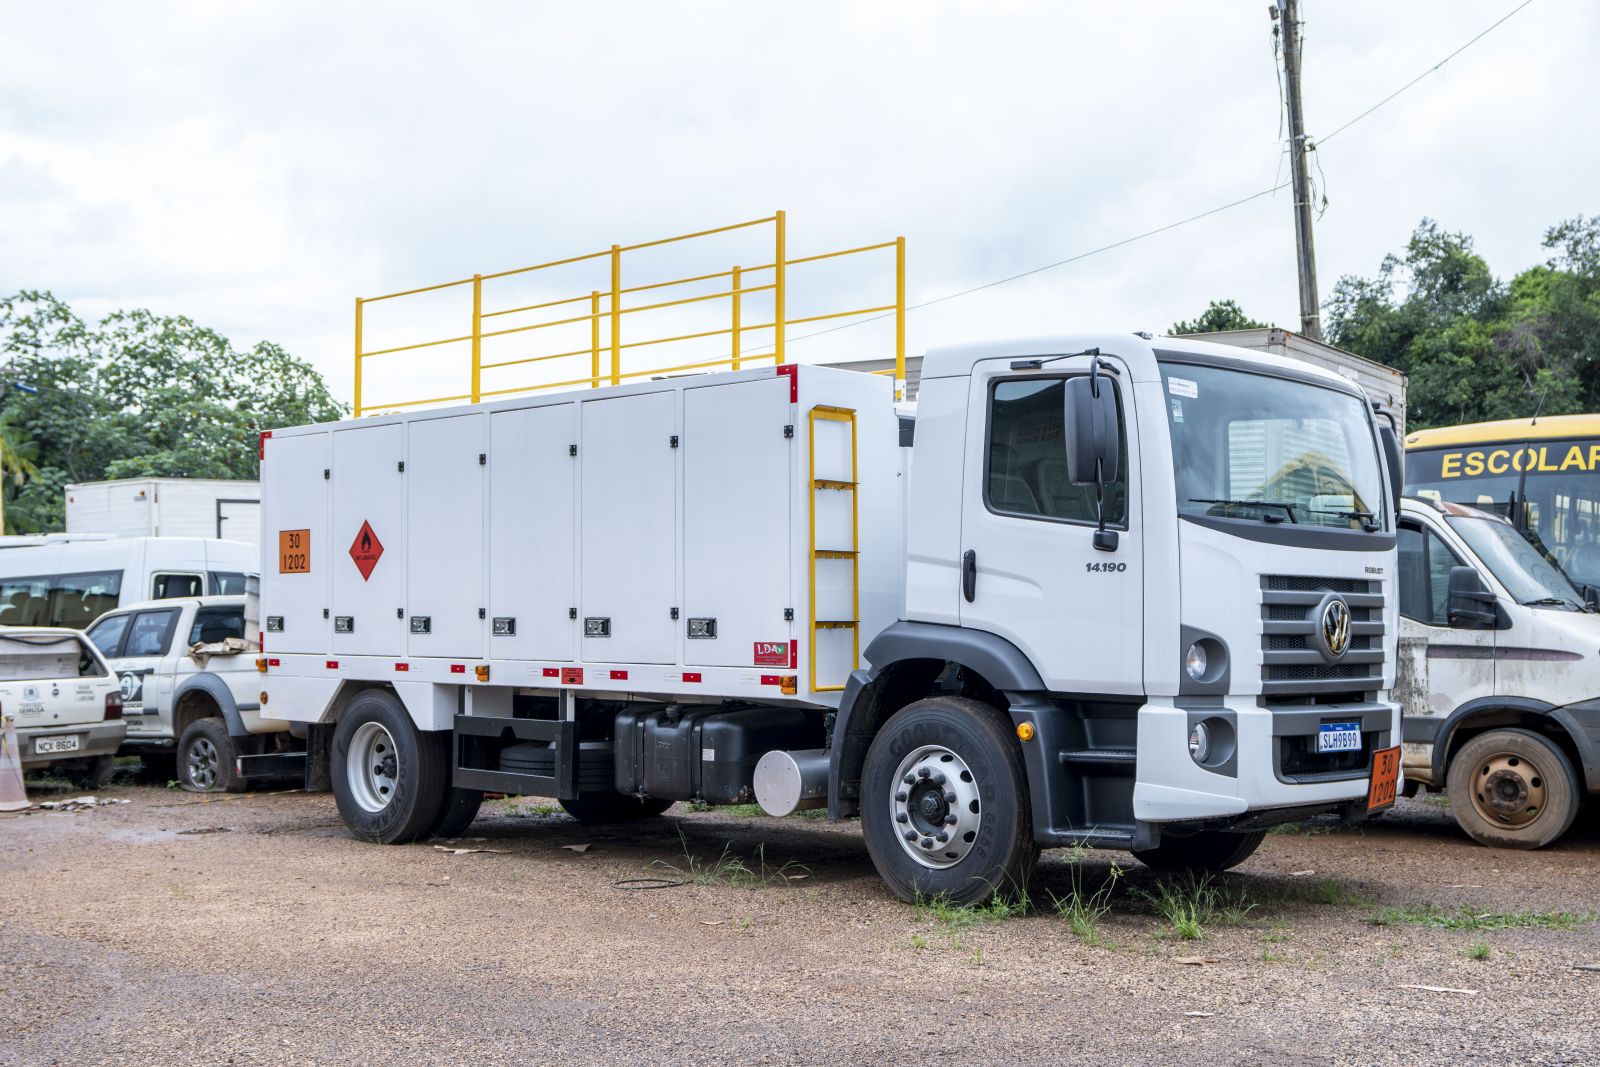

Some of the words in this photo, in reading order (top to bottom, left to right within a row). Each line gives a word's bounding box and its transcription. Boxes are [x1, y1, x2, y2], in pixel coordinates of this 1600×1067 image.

[289, 533, 301, 549] 30
[283, 554, 306, 570] 1202
[1086, 562, 1127, 573] 14.190
[1364, 566, 1384, 575] ROBUST
[1323, 732, 1357, 749] SLH9B99
[1381, 753, 1394, 776] 30
[1371, 779, 1395, 805] 1202
